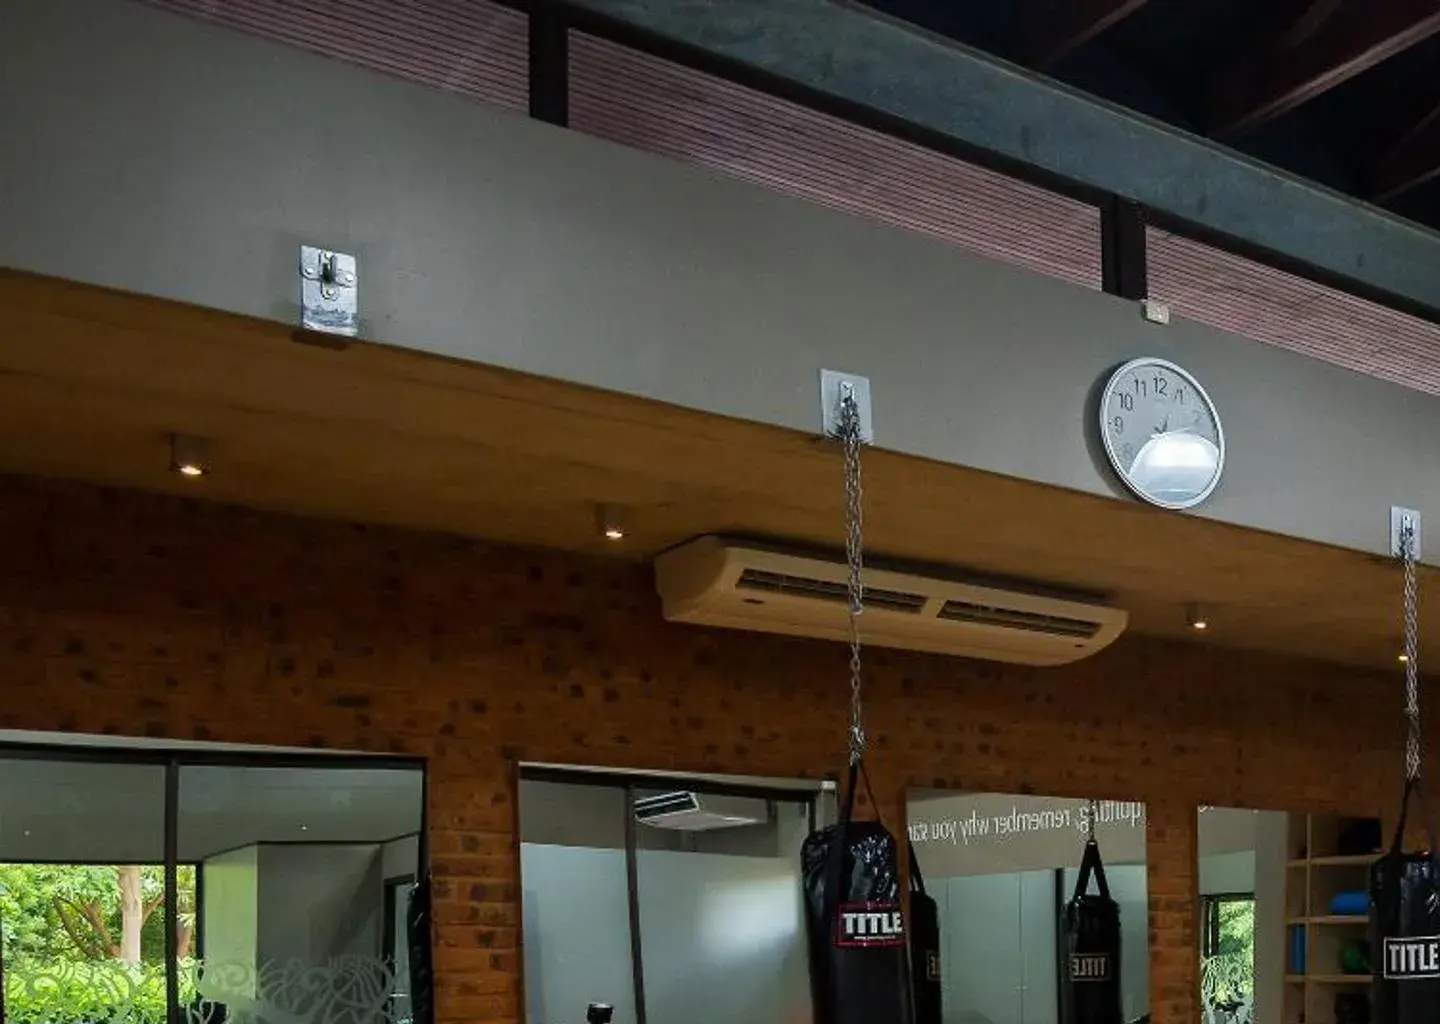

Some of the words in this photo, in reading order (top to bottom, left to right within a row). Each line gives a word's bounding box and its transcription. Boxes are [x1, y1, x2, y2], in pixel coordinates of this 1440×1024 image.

[1134, 379, 1147, 398] 11
[1153, 377, 1167, 398] 12
[1119, 392, 1134, 412] 10
[1114, 416, 1124, 435] 9
[842, 912, 903, 934] TITLE
[1388, 943, 1440, 973] TITLE
